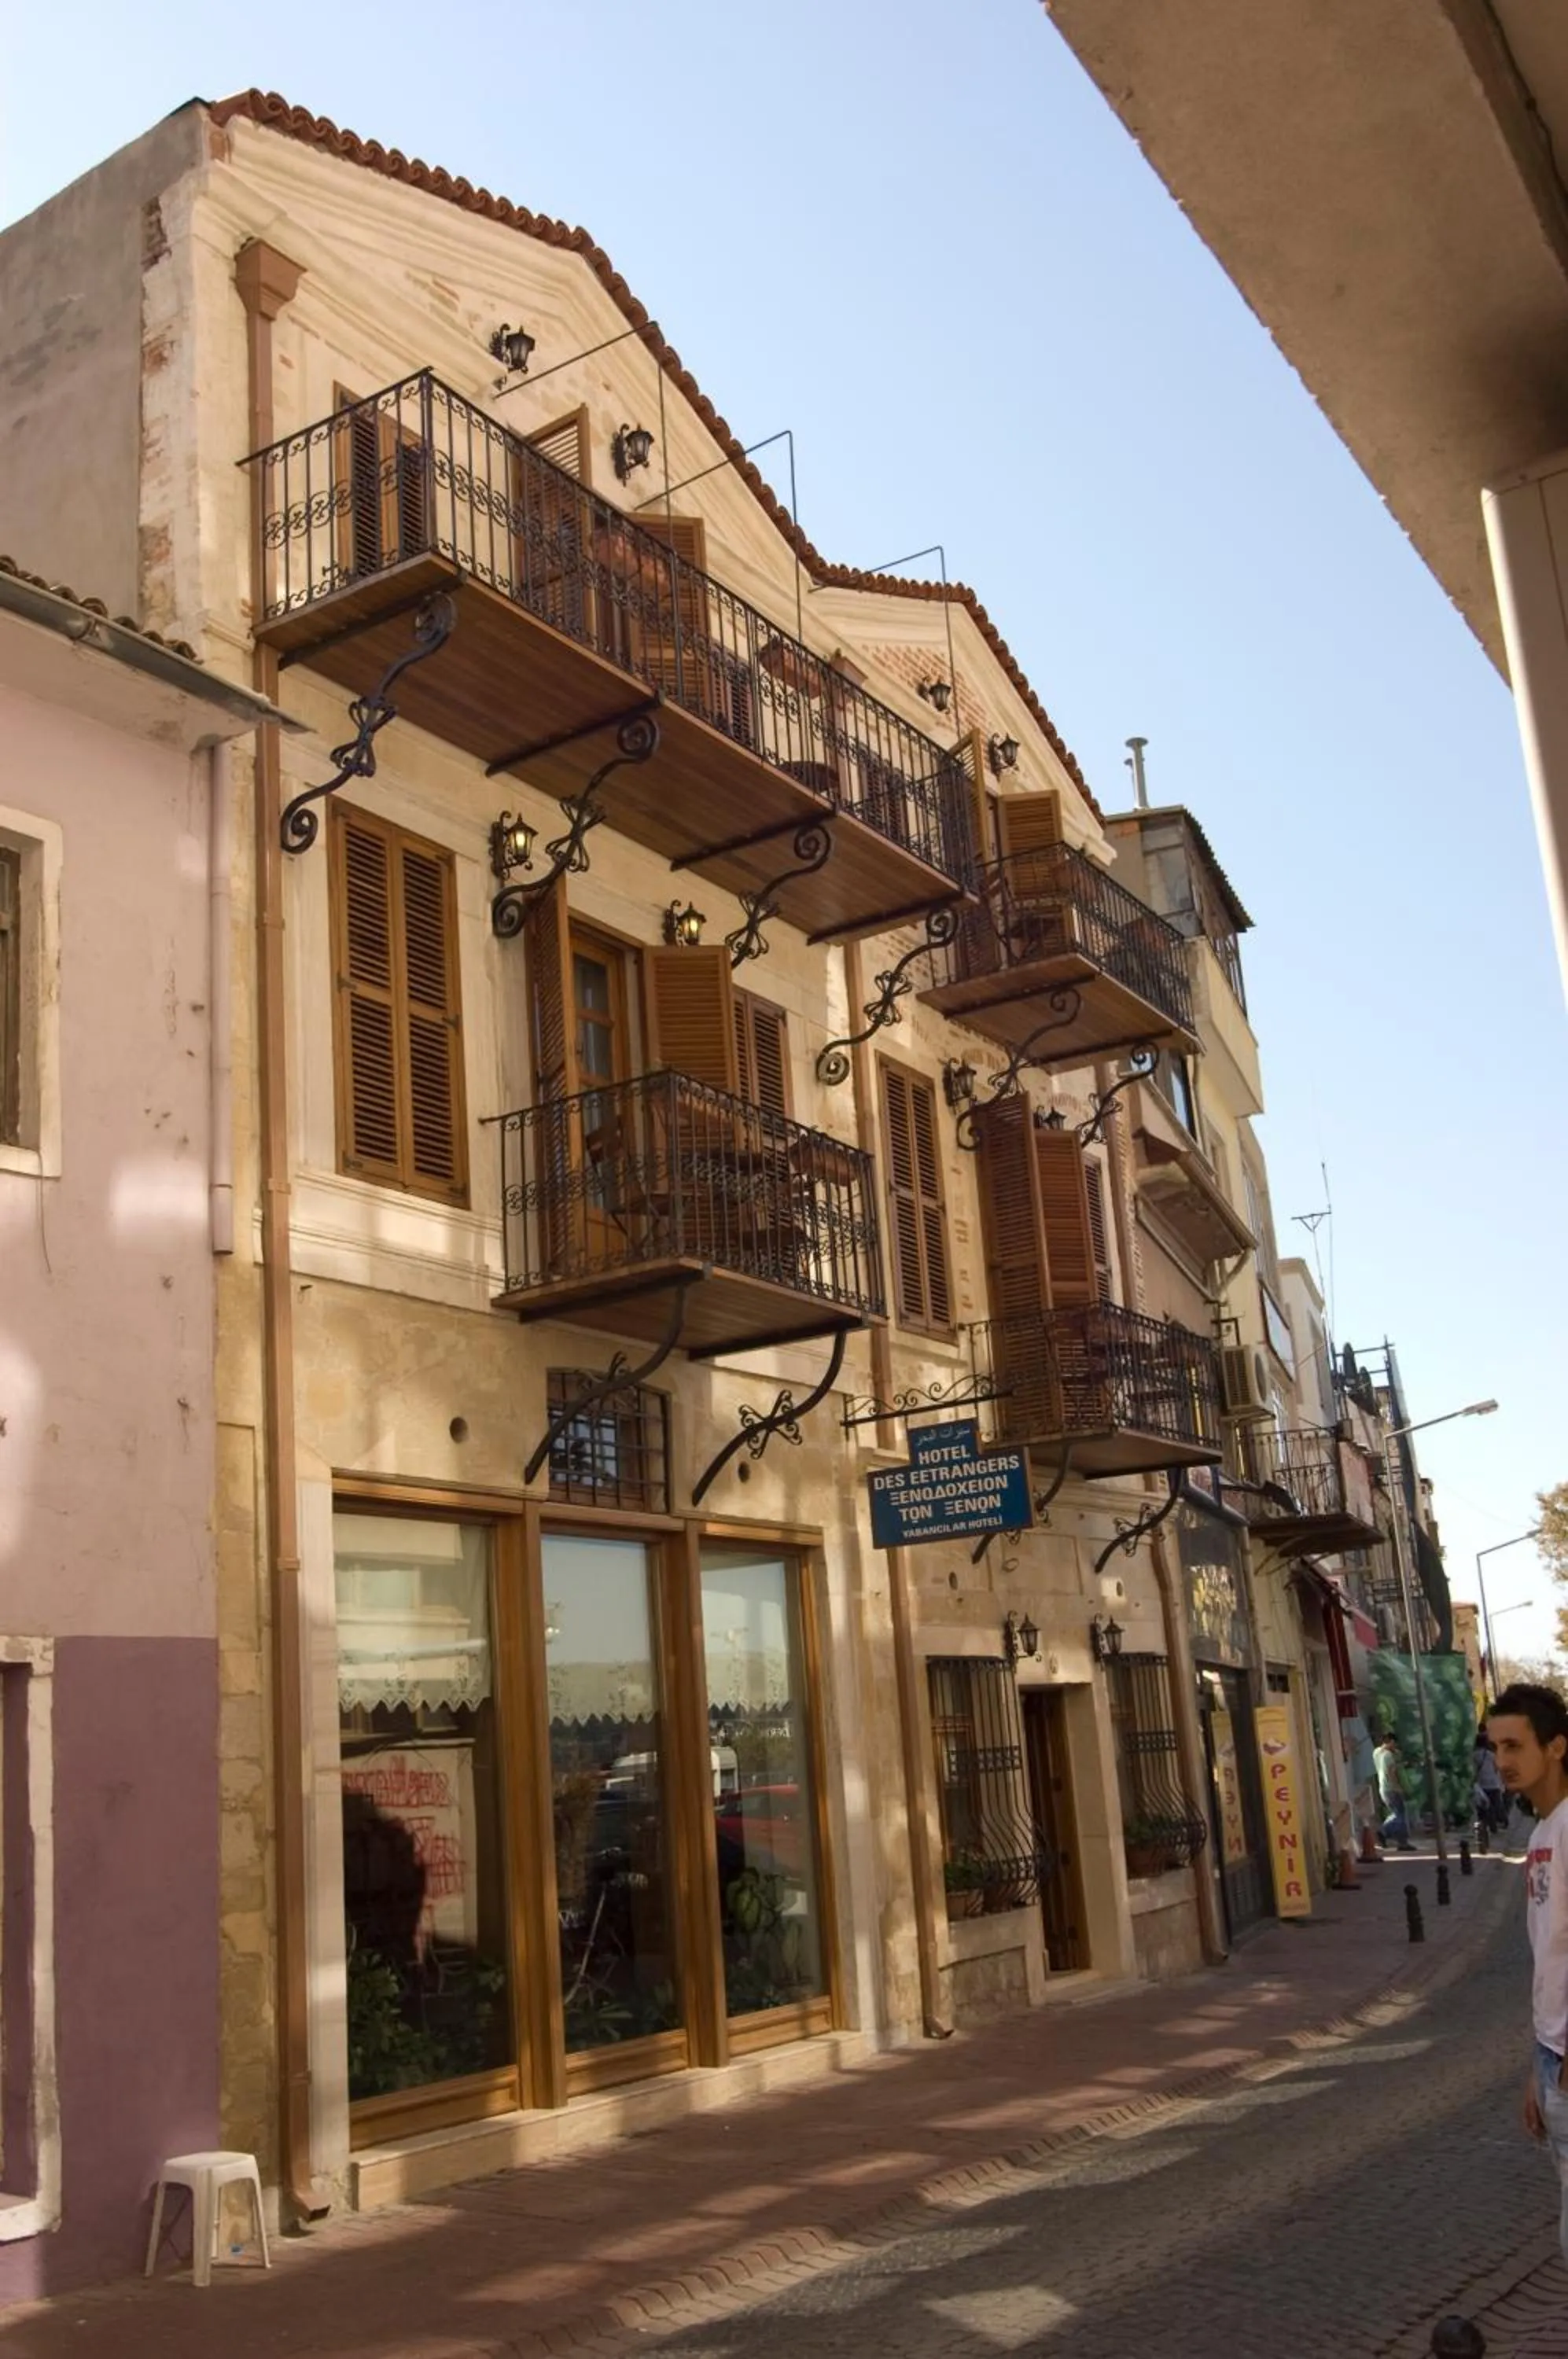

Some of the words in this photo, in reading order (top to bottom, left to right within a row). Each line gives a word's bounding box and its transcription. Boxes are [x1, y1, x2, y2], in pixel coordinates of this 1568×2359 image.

[918, 1444, 970, 1465] HOTEL
[874, 1474, 905, 1490] DES
[910, 1455, 1020, 1485] EETRANGERS
